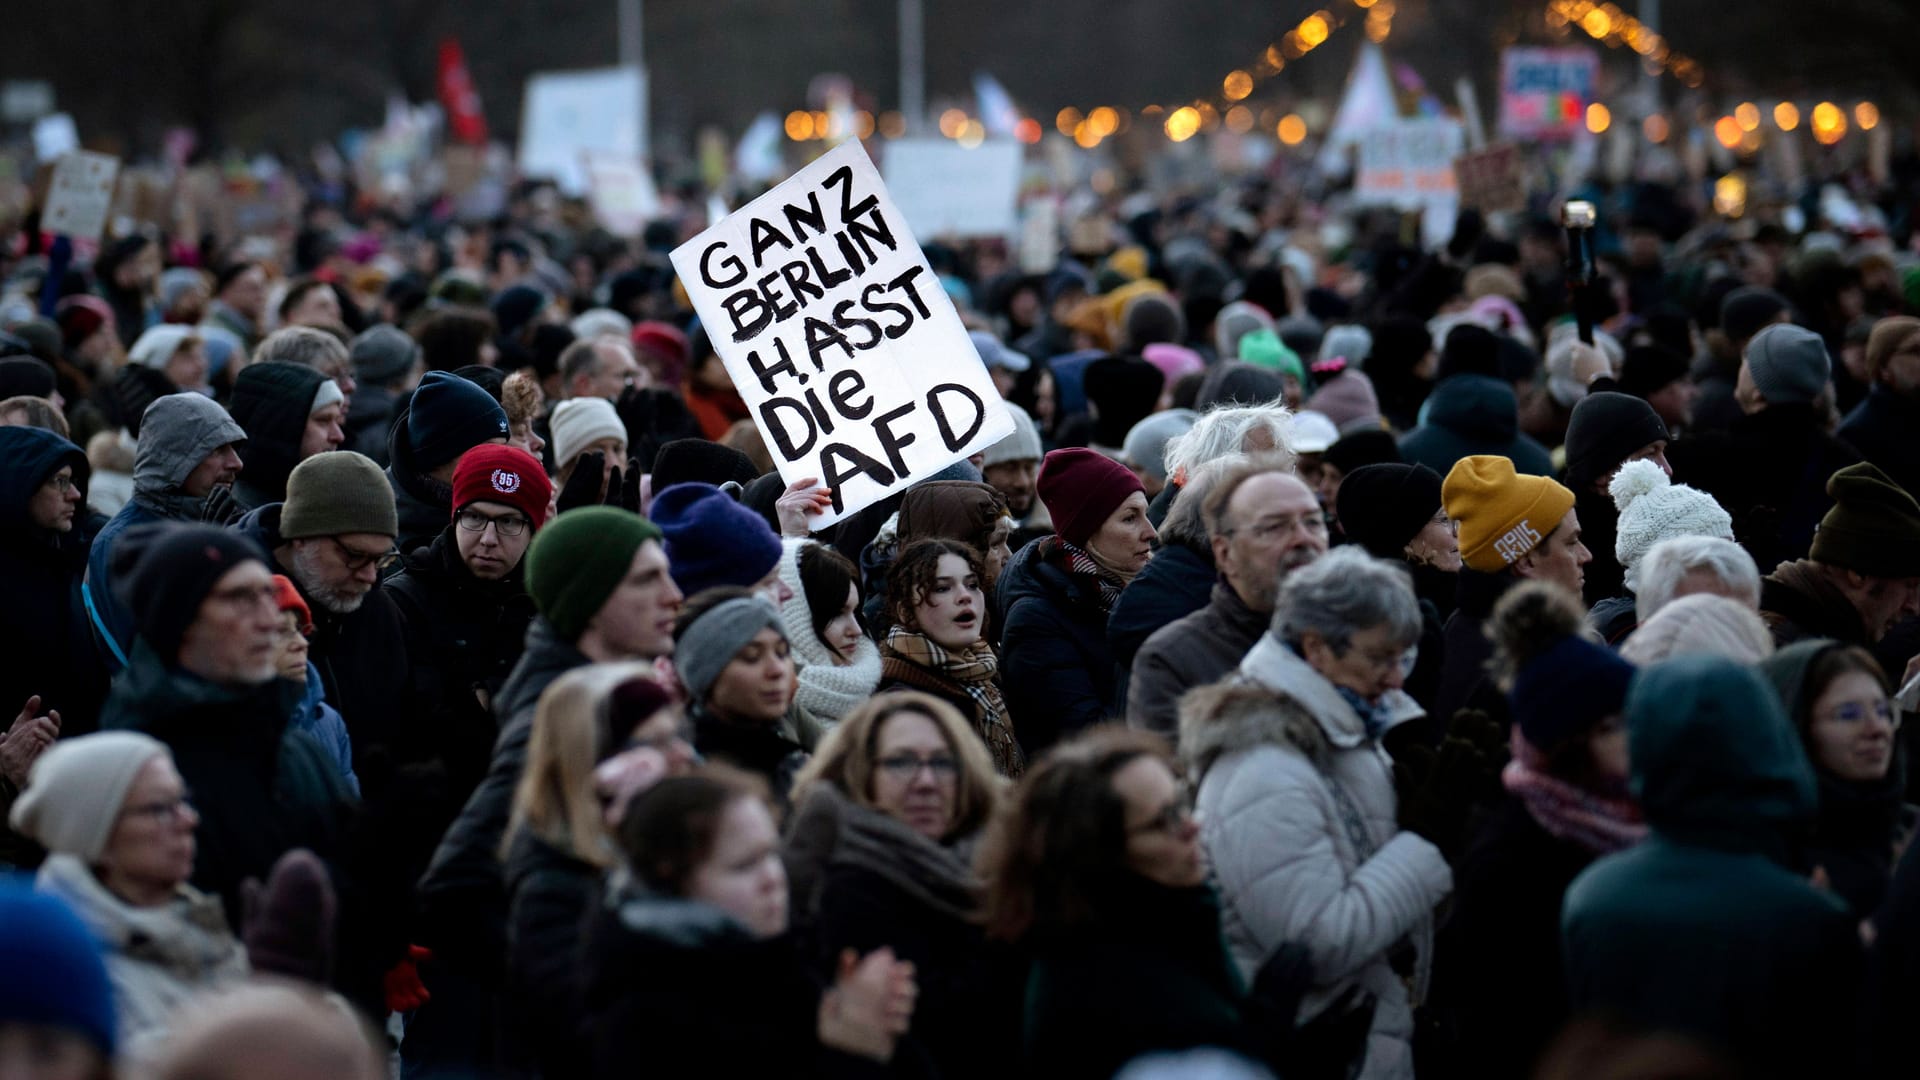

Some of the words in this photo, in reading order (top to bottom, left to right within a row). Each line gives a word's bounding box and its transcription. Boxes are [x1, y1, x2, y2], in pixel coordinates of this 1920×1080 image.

[700, 166, 879, 289] GANZ
[721, 208, 898, 343] BERLIN
[747, 265, 931, 395] HASST
[759, 369, 875, 462] Die
[820, 383, 986, 516] AFD
[499, 473, 514, 487] 95
